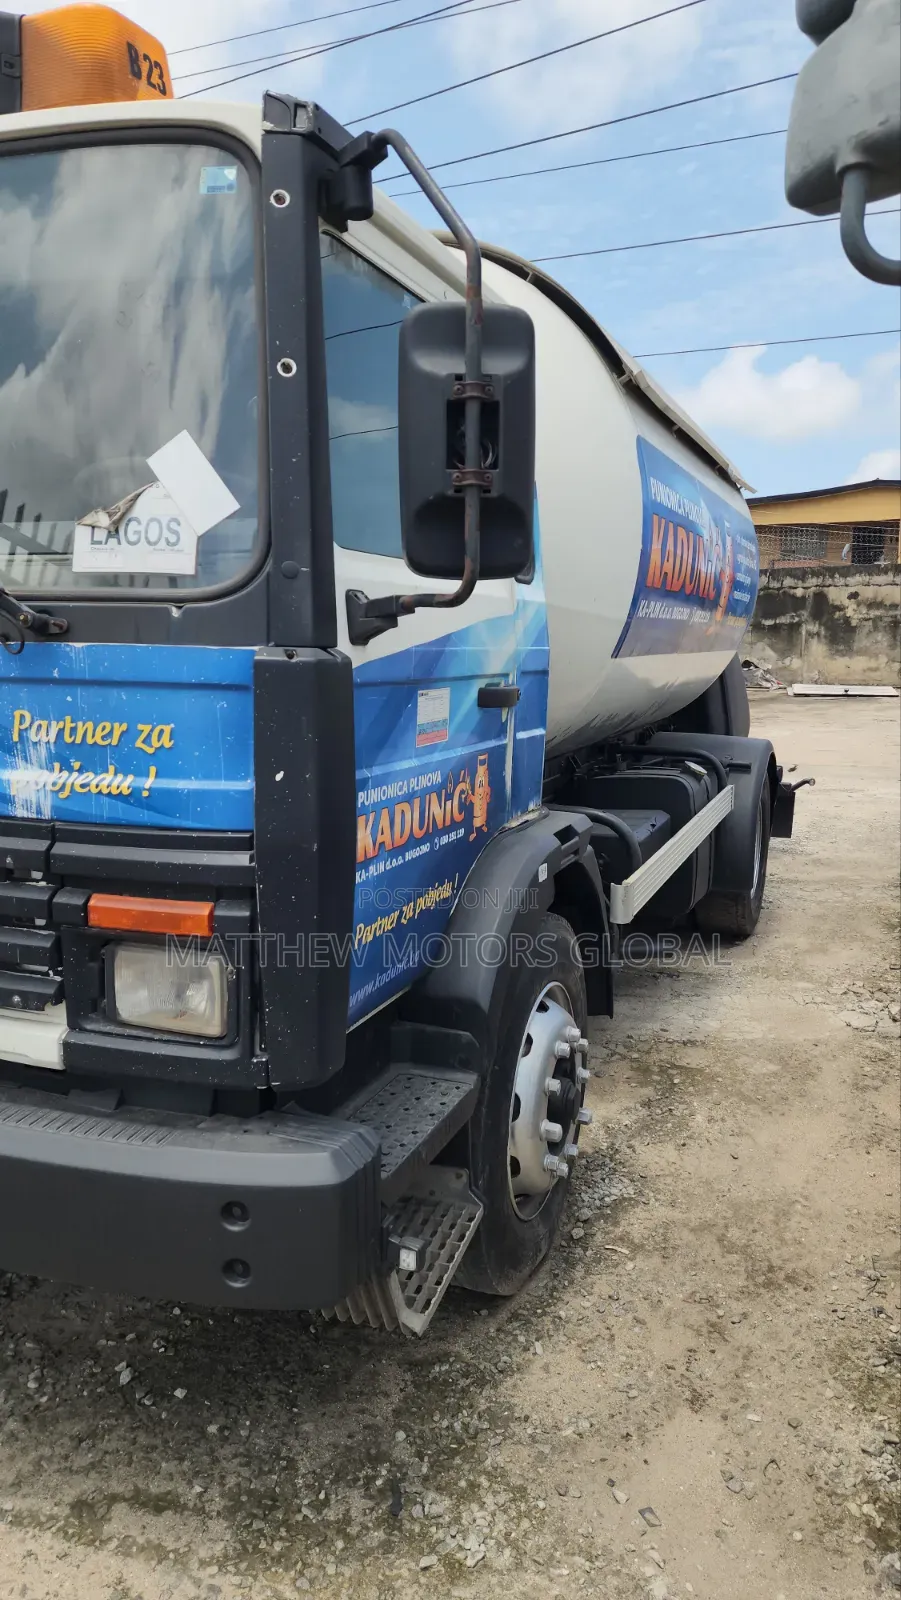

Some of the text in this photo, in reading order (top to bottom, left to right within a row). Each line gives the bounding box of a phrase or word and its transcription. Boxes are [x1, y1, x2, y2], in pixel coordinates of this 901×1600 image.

[127, 41, 167, 96] B 23
[90, 516, 181, 547] LAGOS
[12, 710, 174, 754] Partner za
[357, 770, 442, 807] PUNIONICA PLINOVA
[355, 861, 385, 884] KA-PLIN
[405, 842, 431, 862] BUGOJNO
[354, 910, 400, 950] Partner
[401, 902, 414, 924] za
[415, 879, 452, 919] pobjedu
